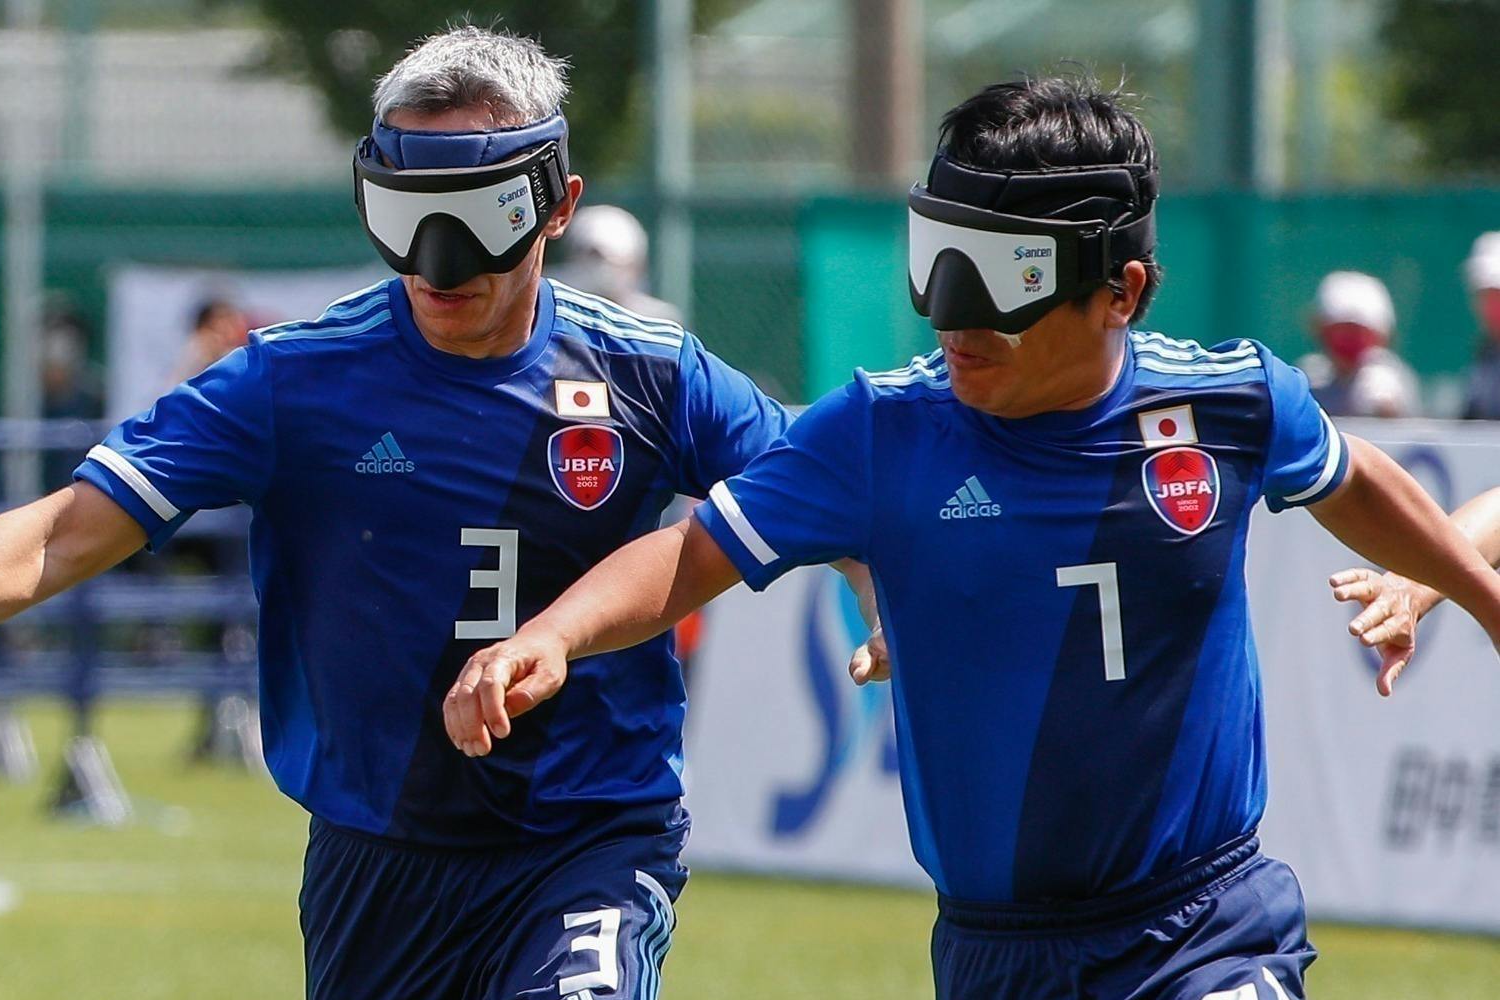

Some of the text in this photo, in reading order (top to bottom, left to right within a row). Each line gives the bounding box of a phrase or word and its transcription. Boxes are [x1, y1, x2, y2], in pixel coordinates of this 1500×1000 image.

[497, 185, 529, 208] Santen
[1013, 245, 1053, 261] Santen
[354, 458, 416, 474] adidas
[557, 457, 616, 473] JBFA
[1155, 479, 1213, 499] JBFA
[939, 503, 1003, 520] adidas
[454, 527, 519, 640] 3
[1055, 562, 1126, 682] 7
[558, 907, 622, 996] 3
